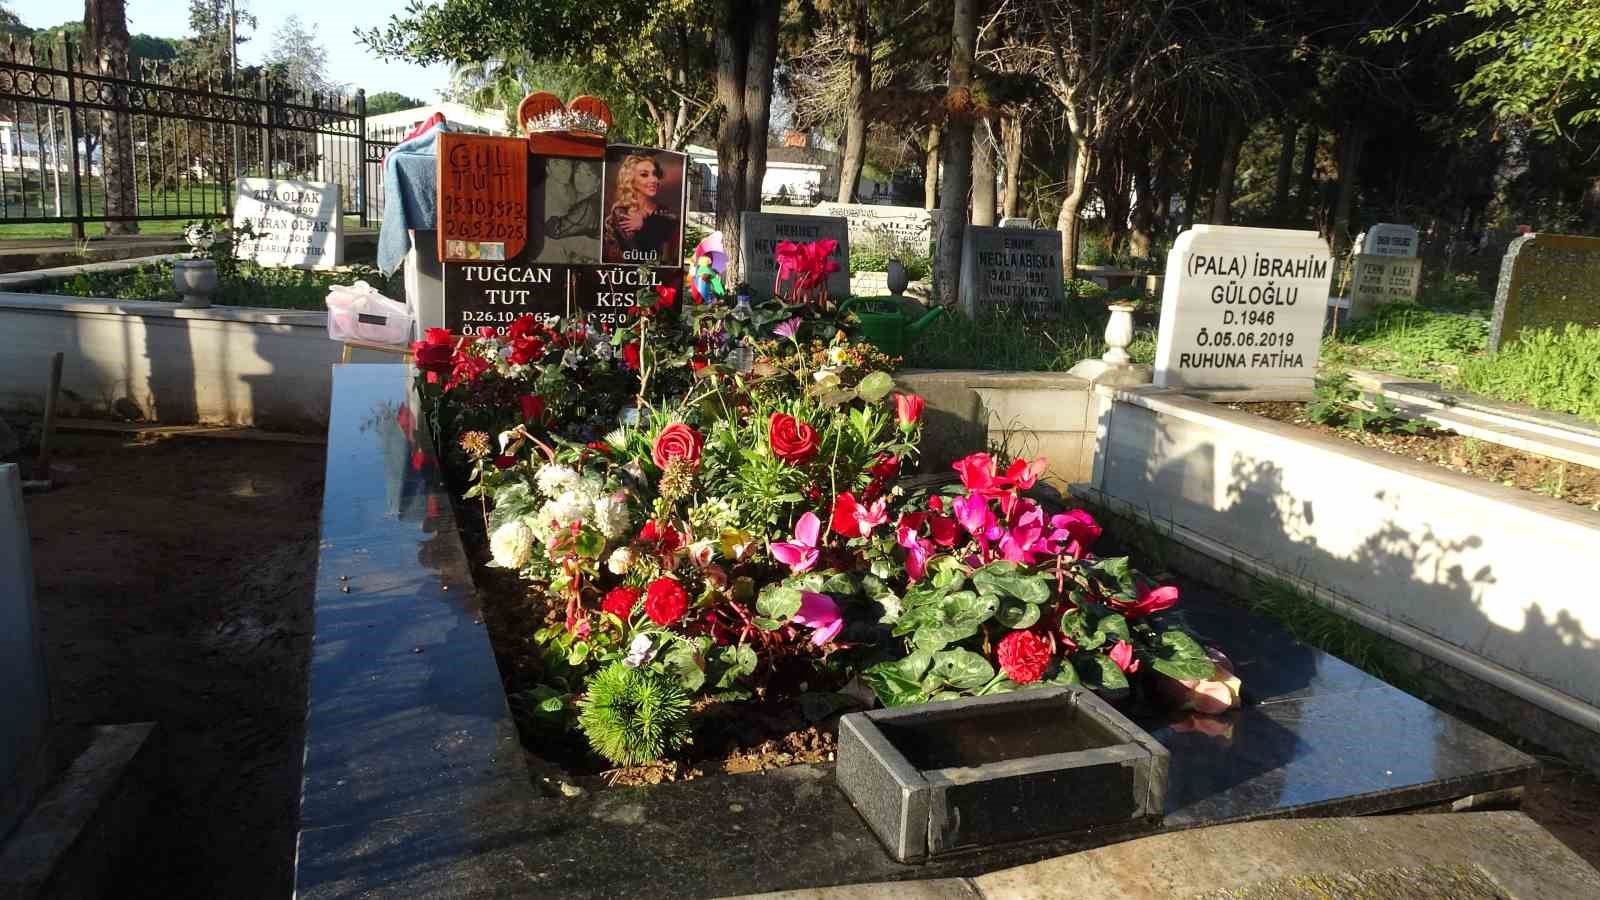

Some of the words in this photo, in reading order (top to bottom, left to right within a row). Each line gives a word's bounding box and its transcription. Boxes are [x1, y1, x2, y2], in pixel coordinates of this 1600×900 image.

[283, 191, 320, 203] OLPAK
[623, 248, 657, 261] GÜLLÜ
[461, 264, 552, 283] TUĞCAN
[1187, 253, 1247, 279] (PALA)
[1253, 252, 1327, 279] İBRAHİM
[485, 289, 531, 305] TUT
[1211, 281, 1298, 306] GÜLOĞLU
[1223, 311, 1275, 325] D.1946
[1196, 328, 1294, 347] Ö.05.06.2019
[1179, 353, 1247, 369] RUHUNA
[1251, 350, 1304, 369] FATİHA
